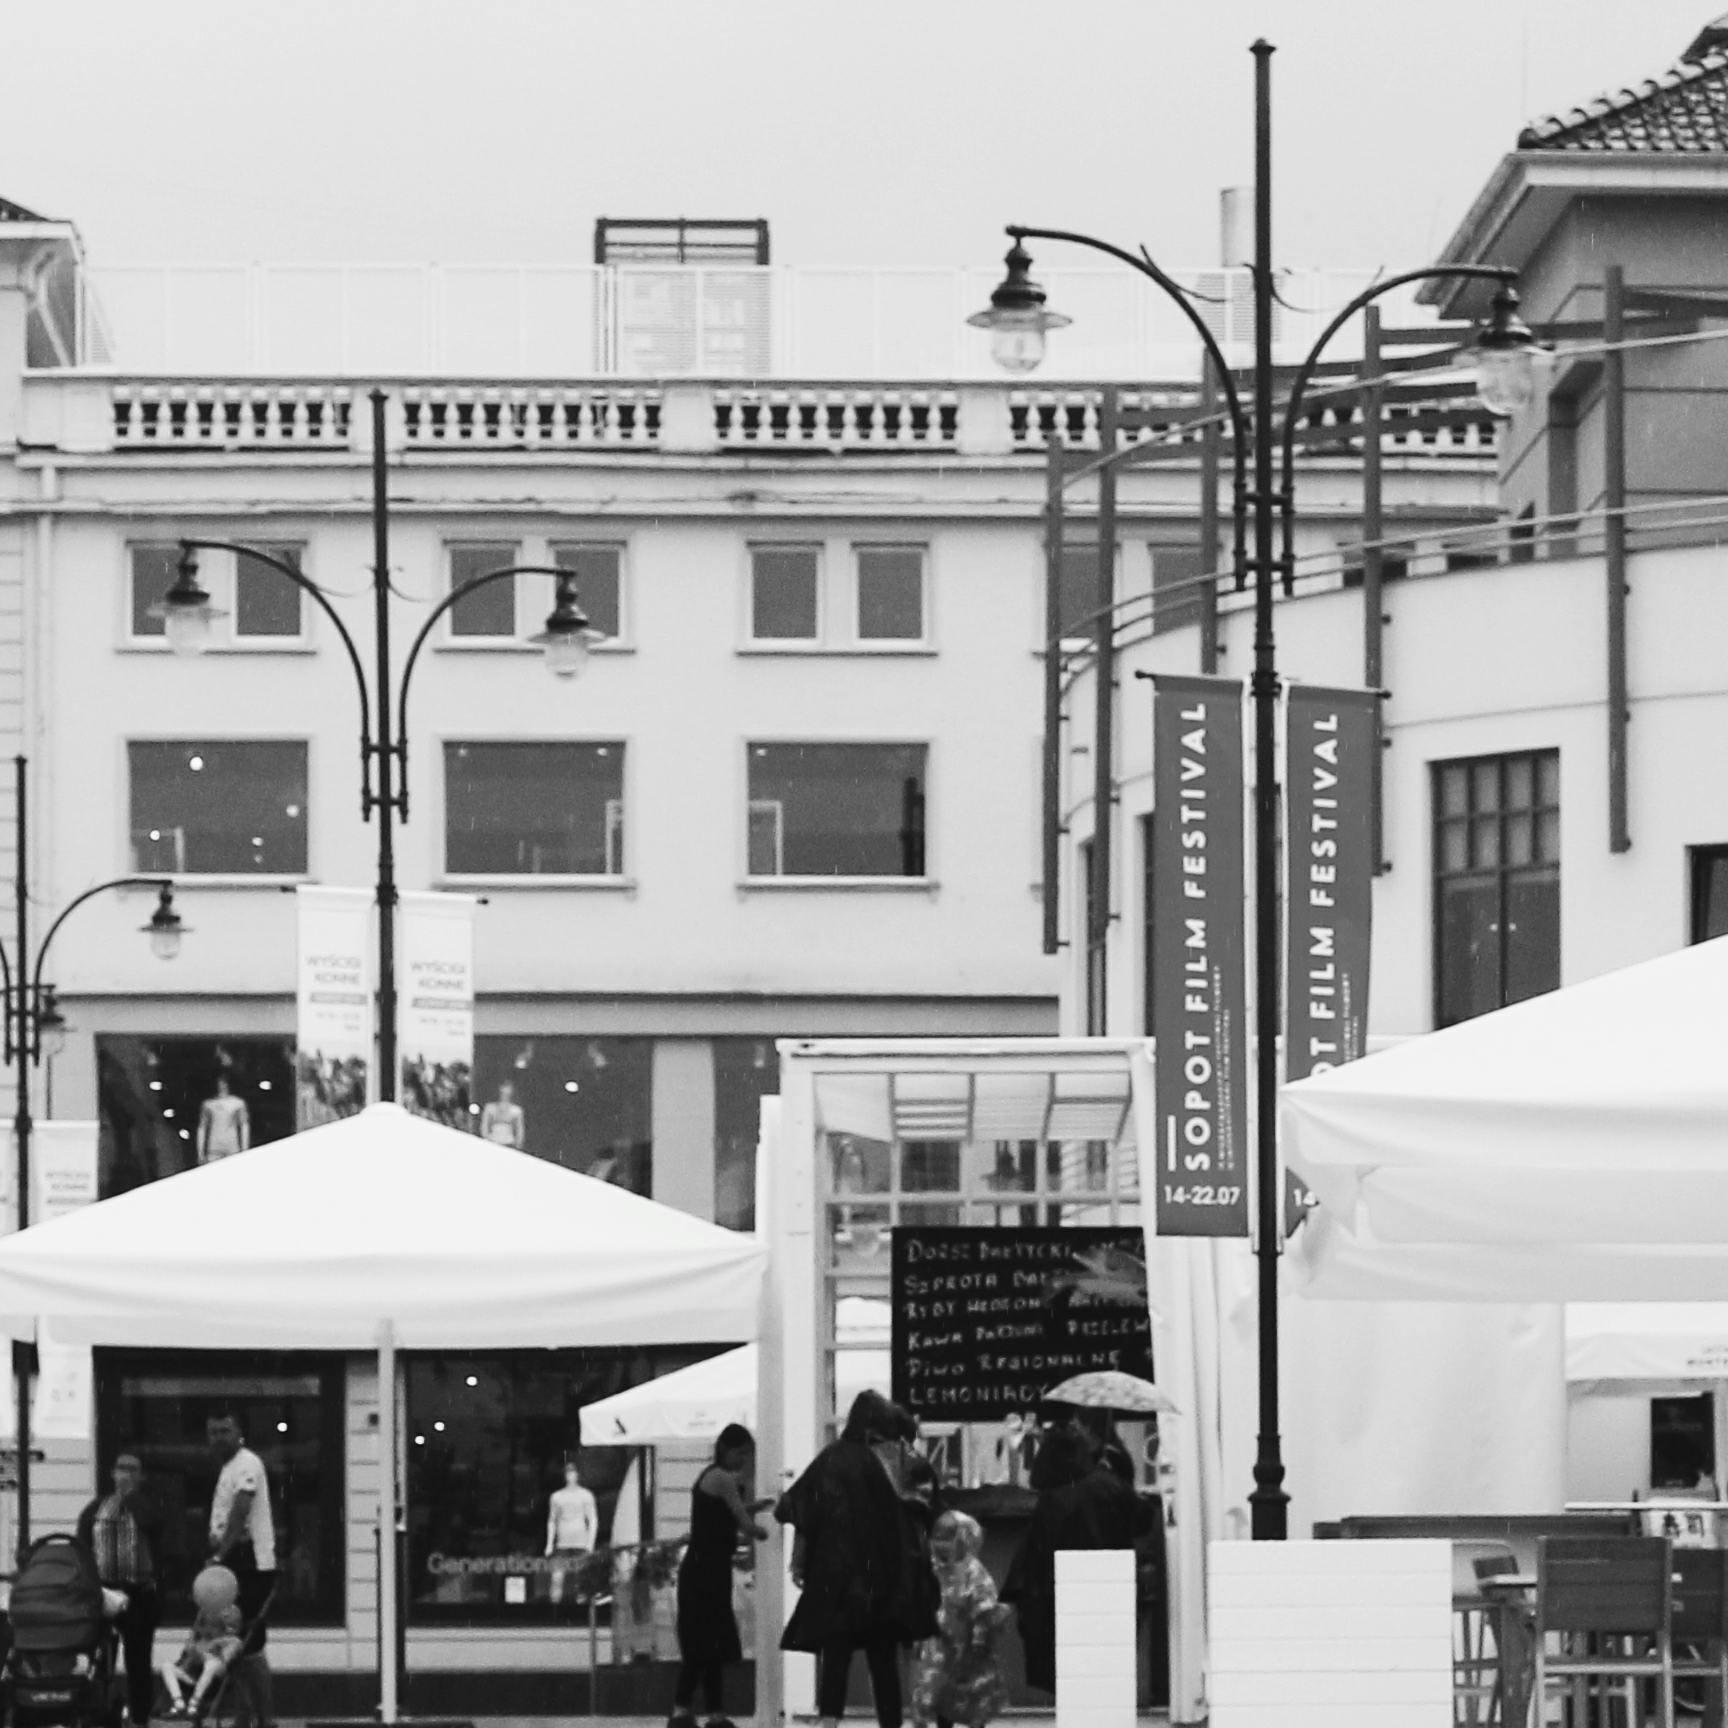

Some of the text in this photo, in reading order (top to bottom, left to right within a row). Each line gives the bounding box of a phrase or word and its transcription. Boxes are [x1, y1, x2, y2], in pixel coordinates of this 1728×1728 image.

[1308, 713, 1339, 907] FESTIVAL
[1180, 703, 1212, 1171] SOPOT FILM FESTIVAL
[1308, 926, 1336, 1020] FILM
[1164, 1184, 1241, 1206] 14-22.07
